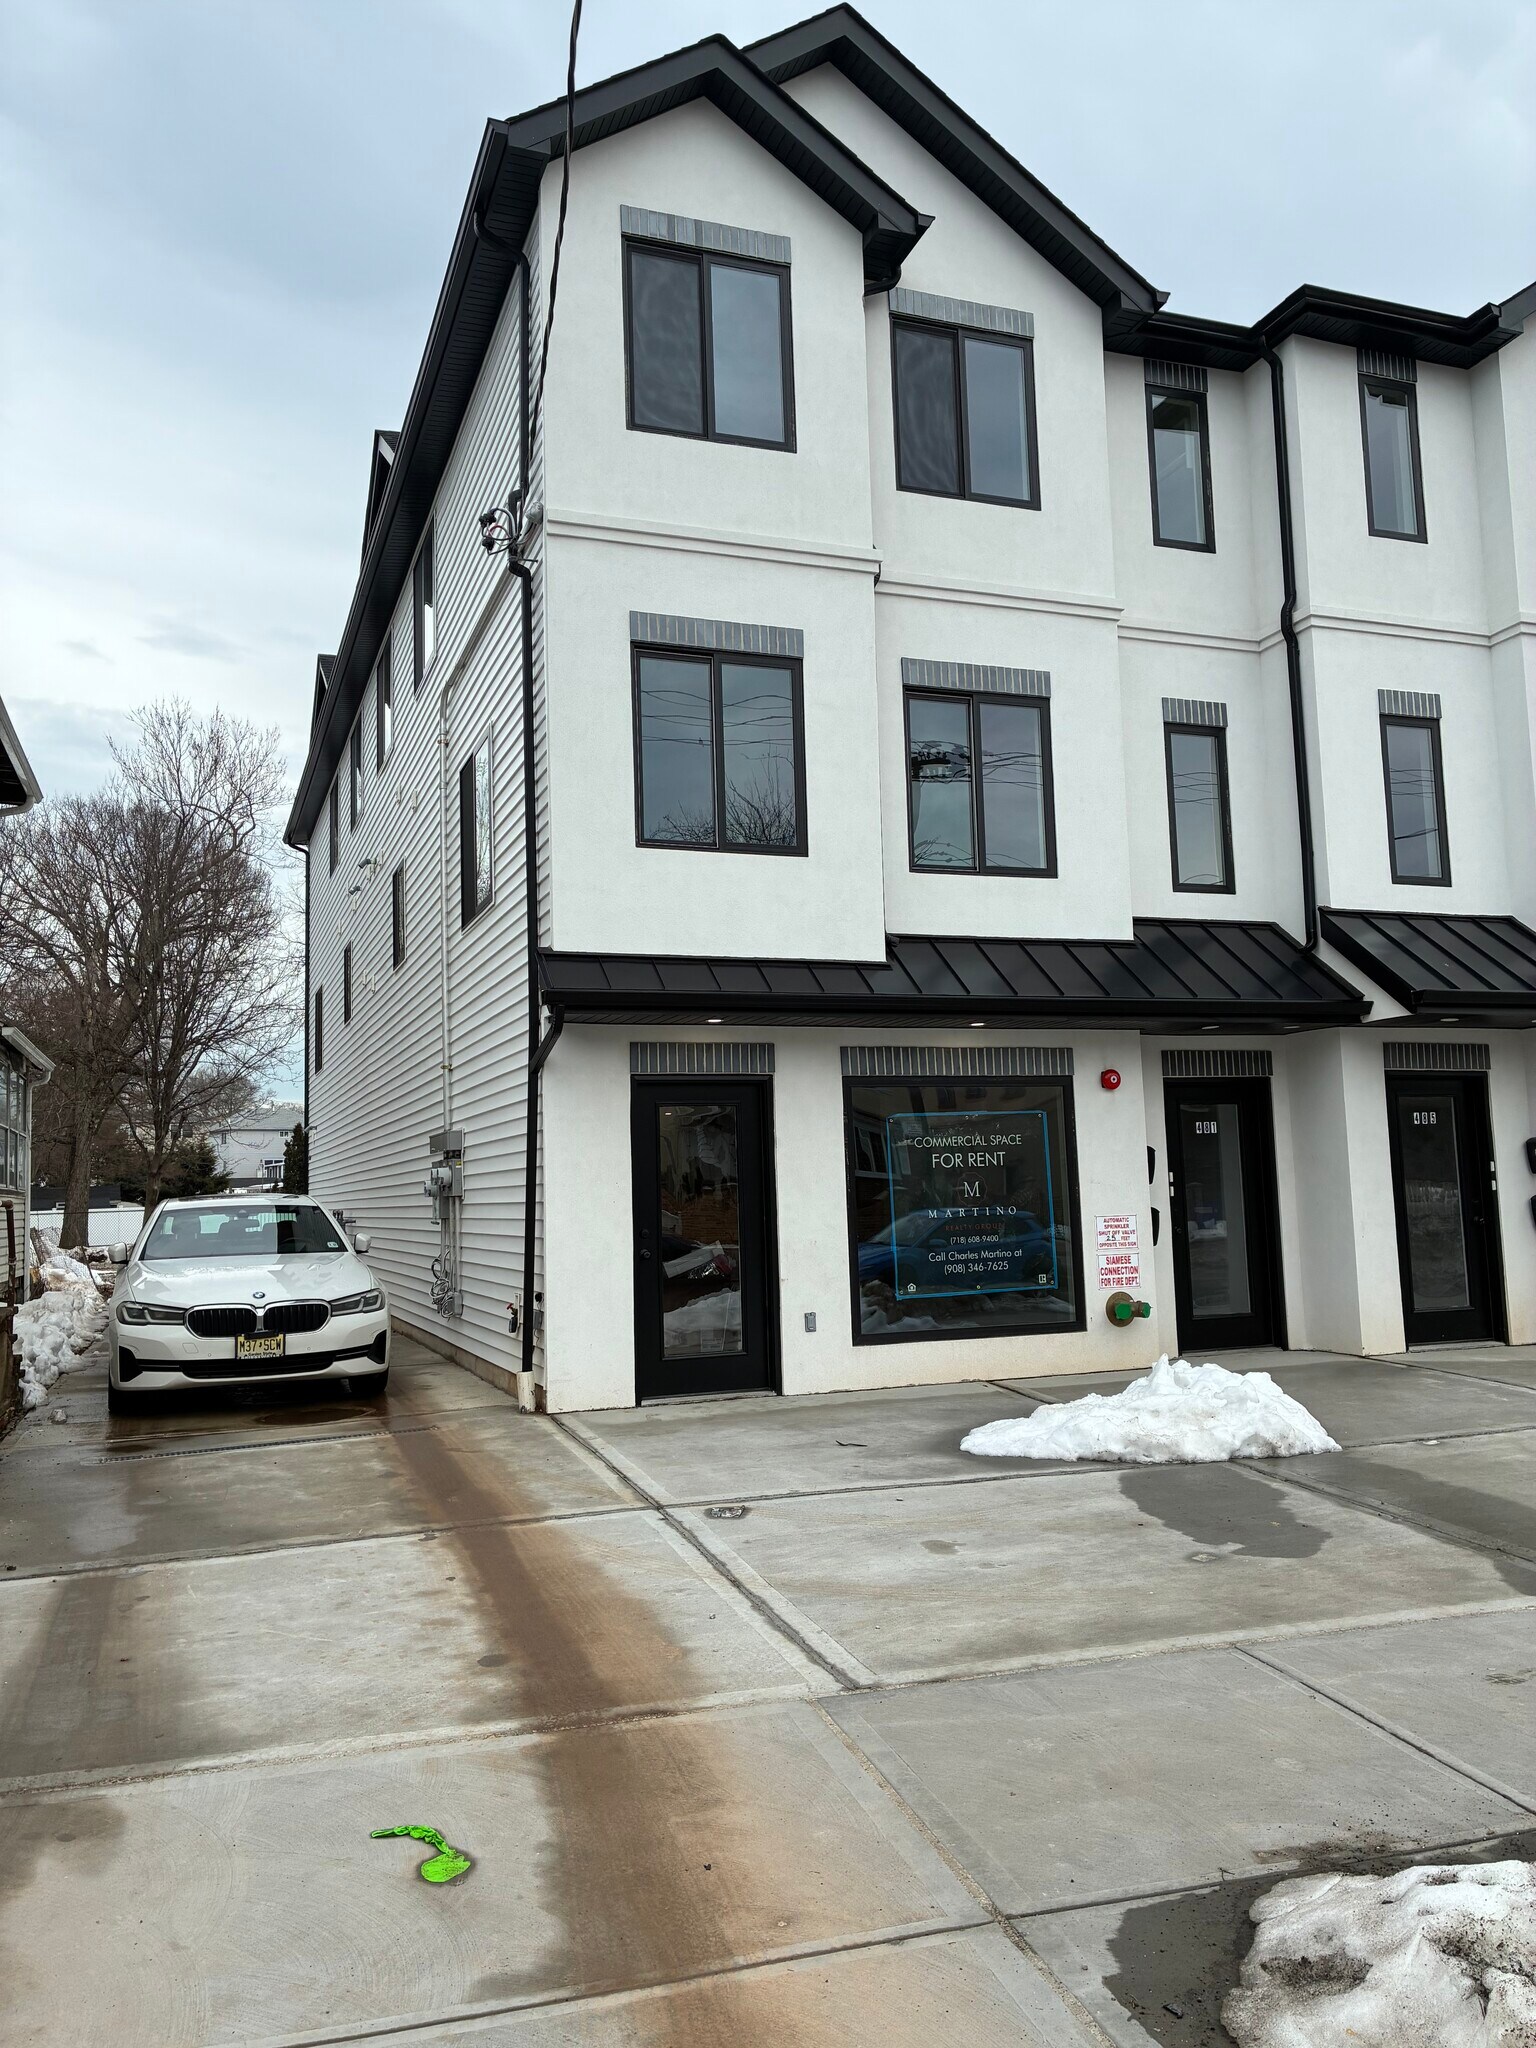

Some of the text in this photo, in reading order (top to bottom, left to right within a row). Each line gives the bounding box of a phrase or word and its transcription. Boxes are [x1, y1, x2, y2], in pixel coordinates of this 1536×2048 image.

[1413, 1111, 1436, 1124] 485
[1195, 1121, 1217, 1134] 481
[914, 1134, 1022, 1148] COMMERCIAL SPACE
[932, 1151, 1006, 1169] FOR RENT
[963, 1181, 981, 1198] M
[928, 1206, 1017, 1219] MARTINO
[950, 1234, 999, 1246] (718) 608-9400
[928, 1248, 1023, 1262] Call Charles Martino at
[1105, 1255, 1132, 1265] SIAMESE
[944, 1260, 1009, 1276] (908) 346-7625
[1100, 1266, 1139, 1276] CONNECTION
[1100, 1278, 1112, 1287] FOR
[1112, 1277, 1124, 1286] FIRE
